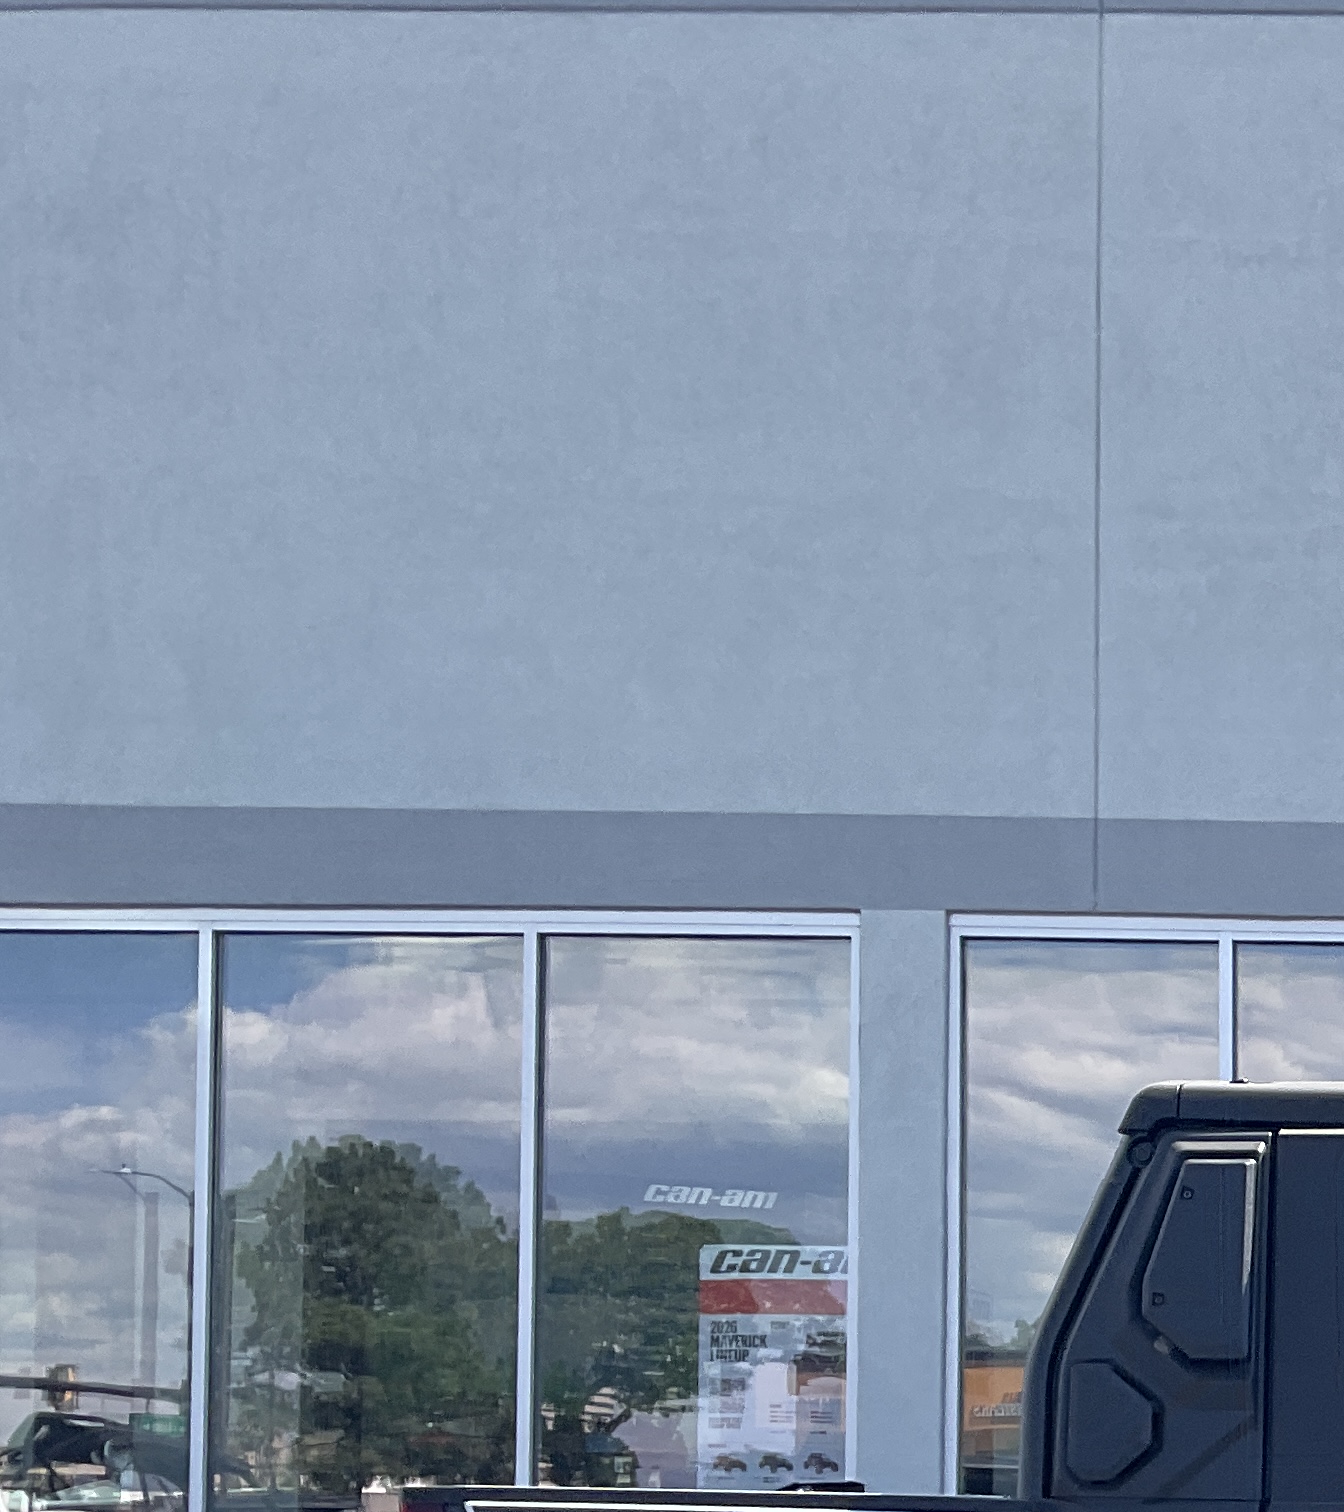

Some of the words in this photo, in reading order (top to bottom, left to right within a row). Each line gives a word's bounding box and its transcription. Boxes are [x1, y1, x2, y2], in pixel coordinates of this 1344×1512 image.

[643, 1184, 779, 1210] can-am
[709, 1249, 849, 1275] can-a
[710, 1334, 769, 1349] MAVERICK
